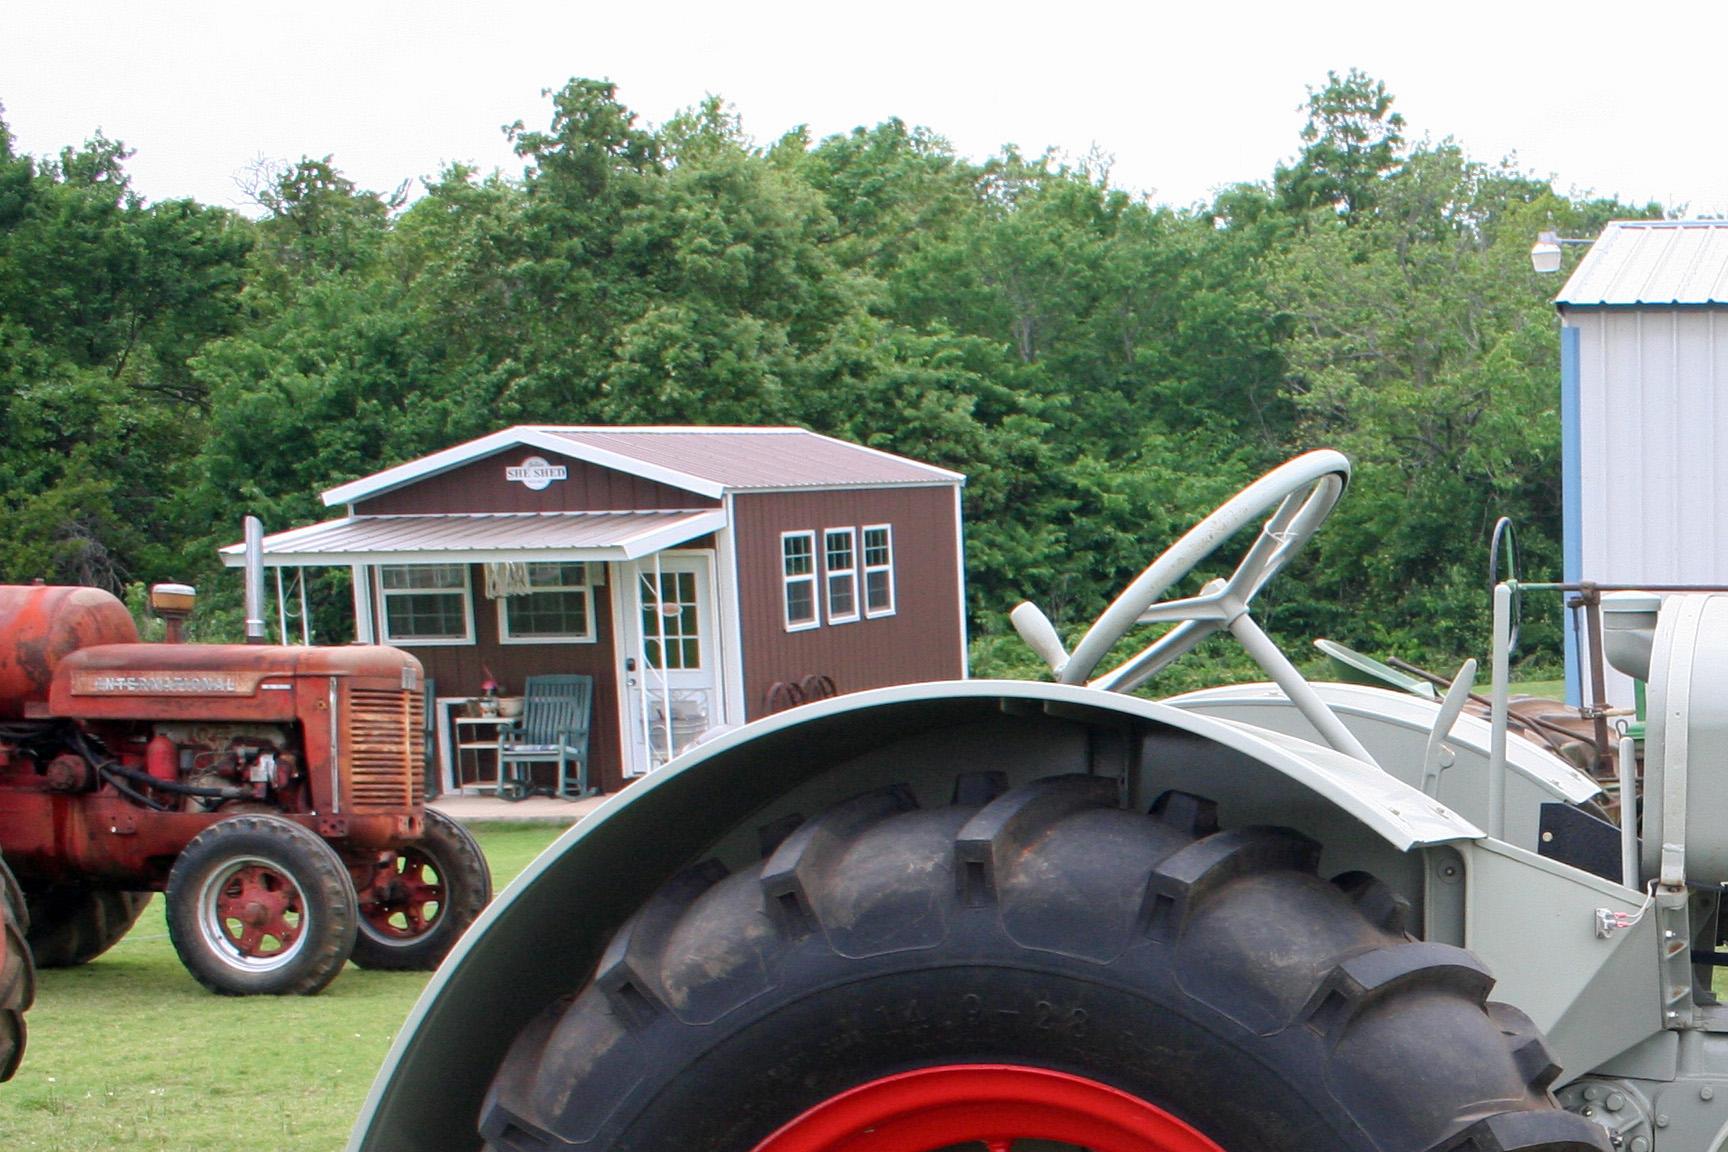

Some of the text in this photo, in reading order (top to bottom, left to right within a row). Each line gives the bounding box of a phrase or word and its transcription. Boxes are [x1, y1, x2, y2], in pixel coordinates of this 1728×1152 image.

[507, 467, 566, 479] SHE SHED
[95, 676, 237, 692] INTERNATIONAL
